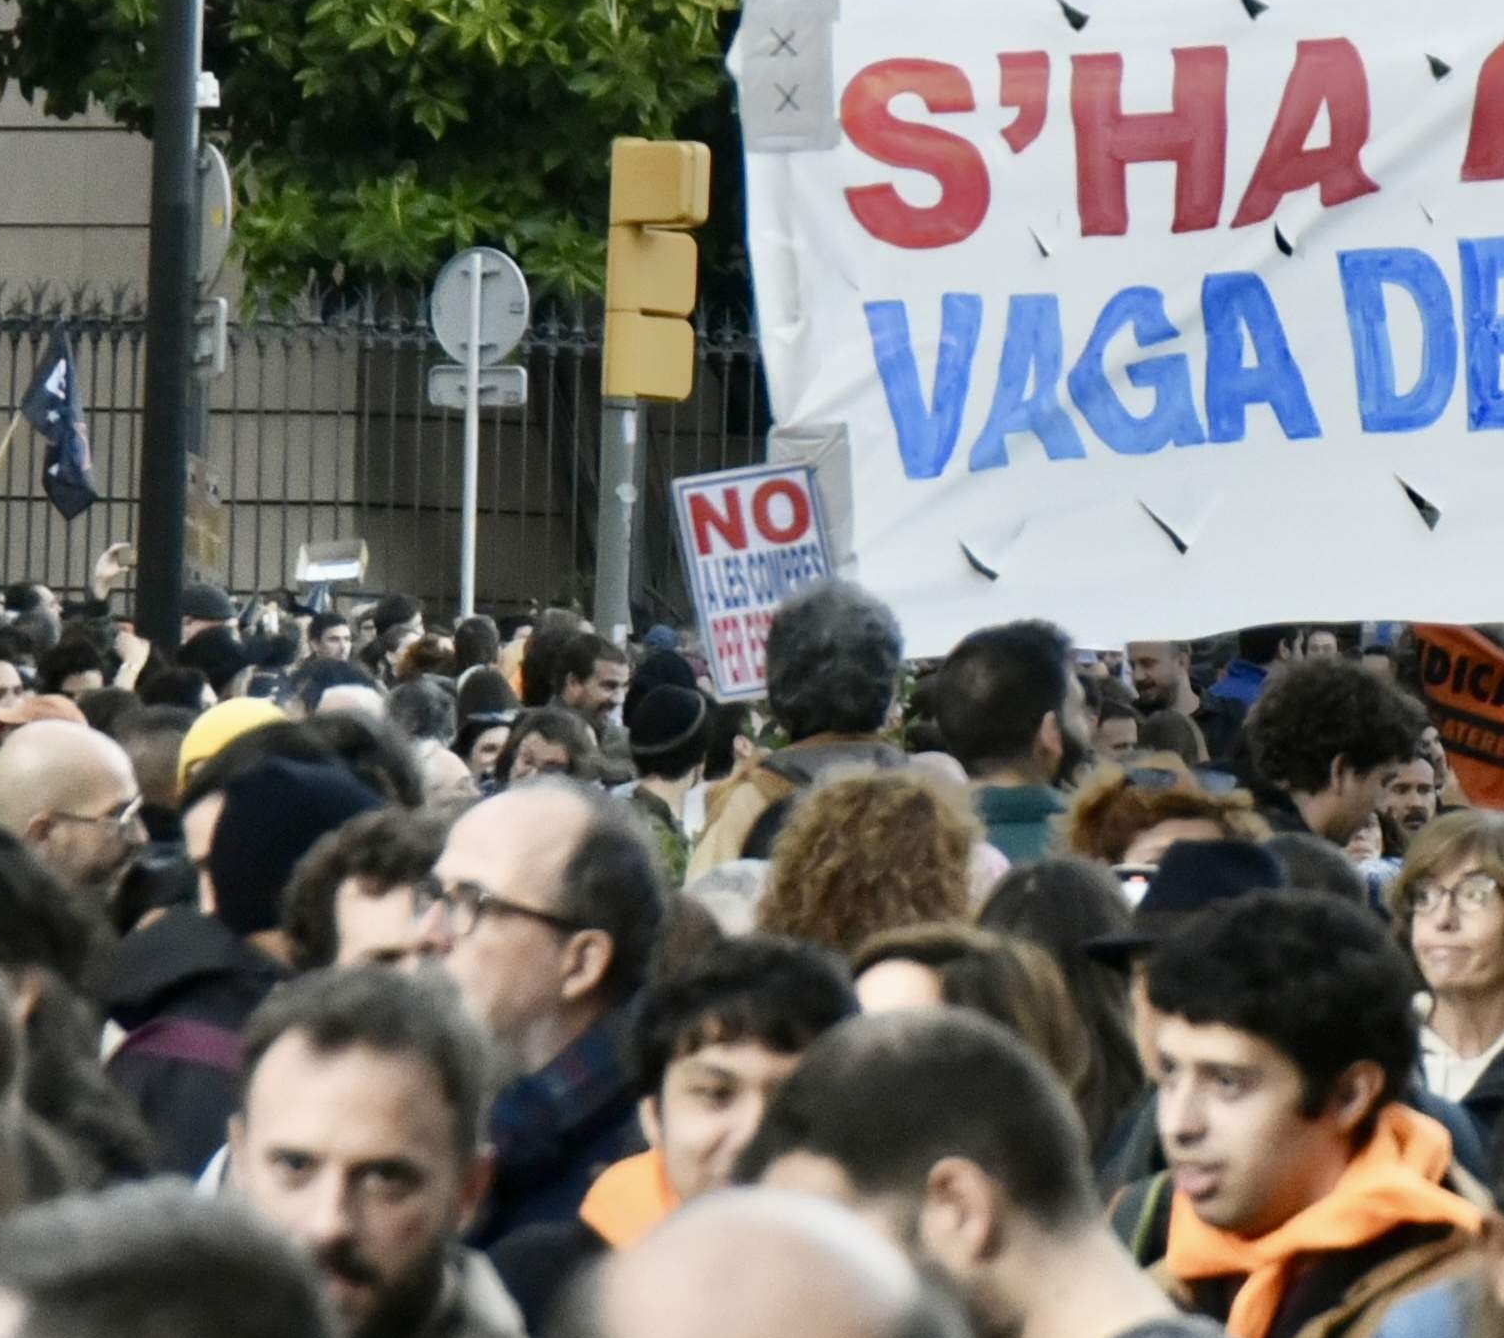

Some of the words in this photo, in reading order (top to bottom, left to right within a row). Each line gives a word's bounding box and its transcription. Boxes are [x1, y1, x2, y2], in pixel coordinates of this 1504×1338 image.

[839, 36, 1382, 251] S'HA
[862, 270, 1324, 481] VAGA
[688, 477, 811, 557] NO
